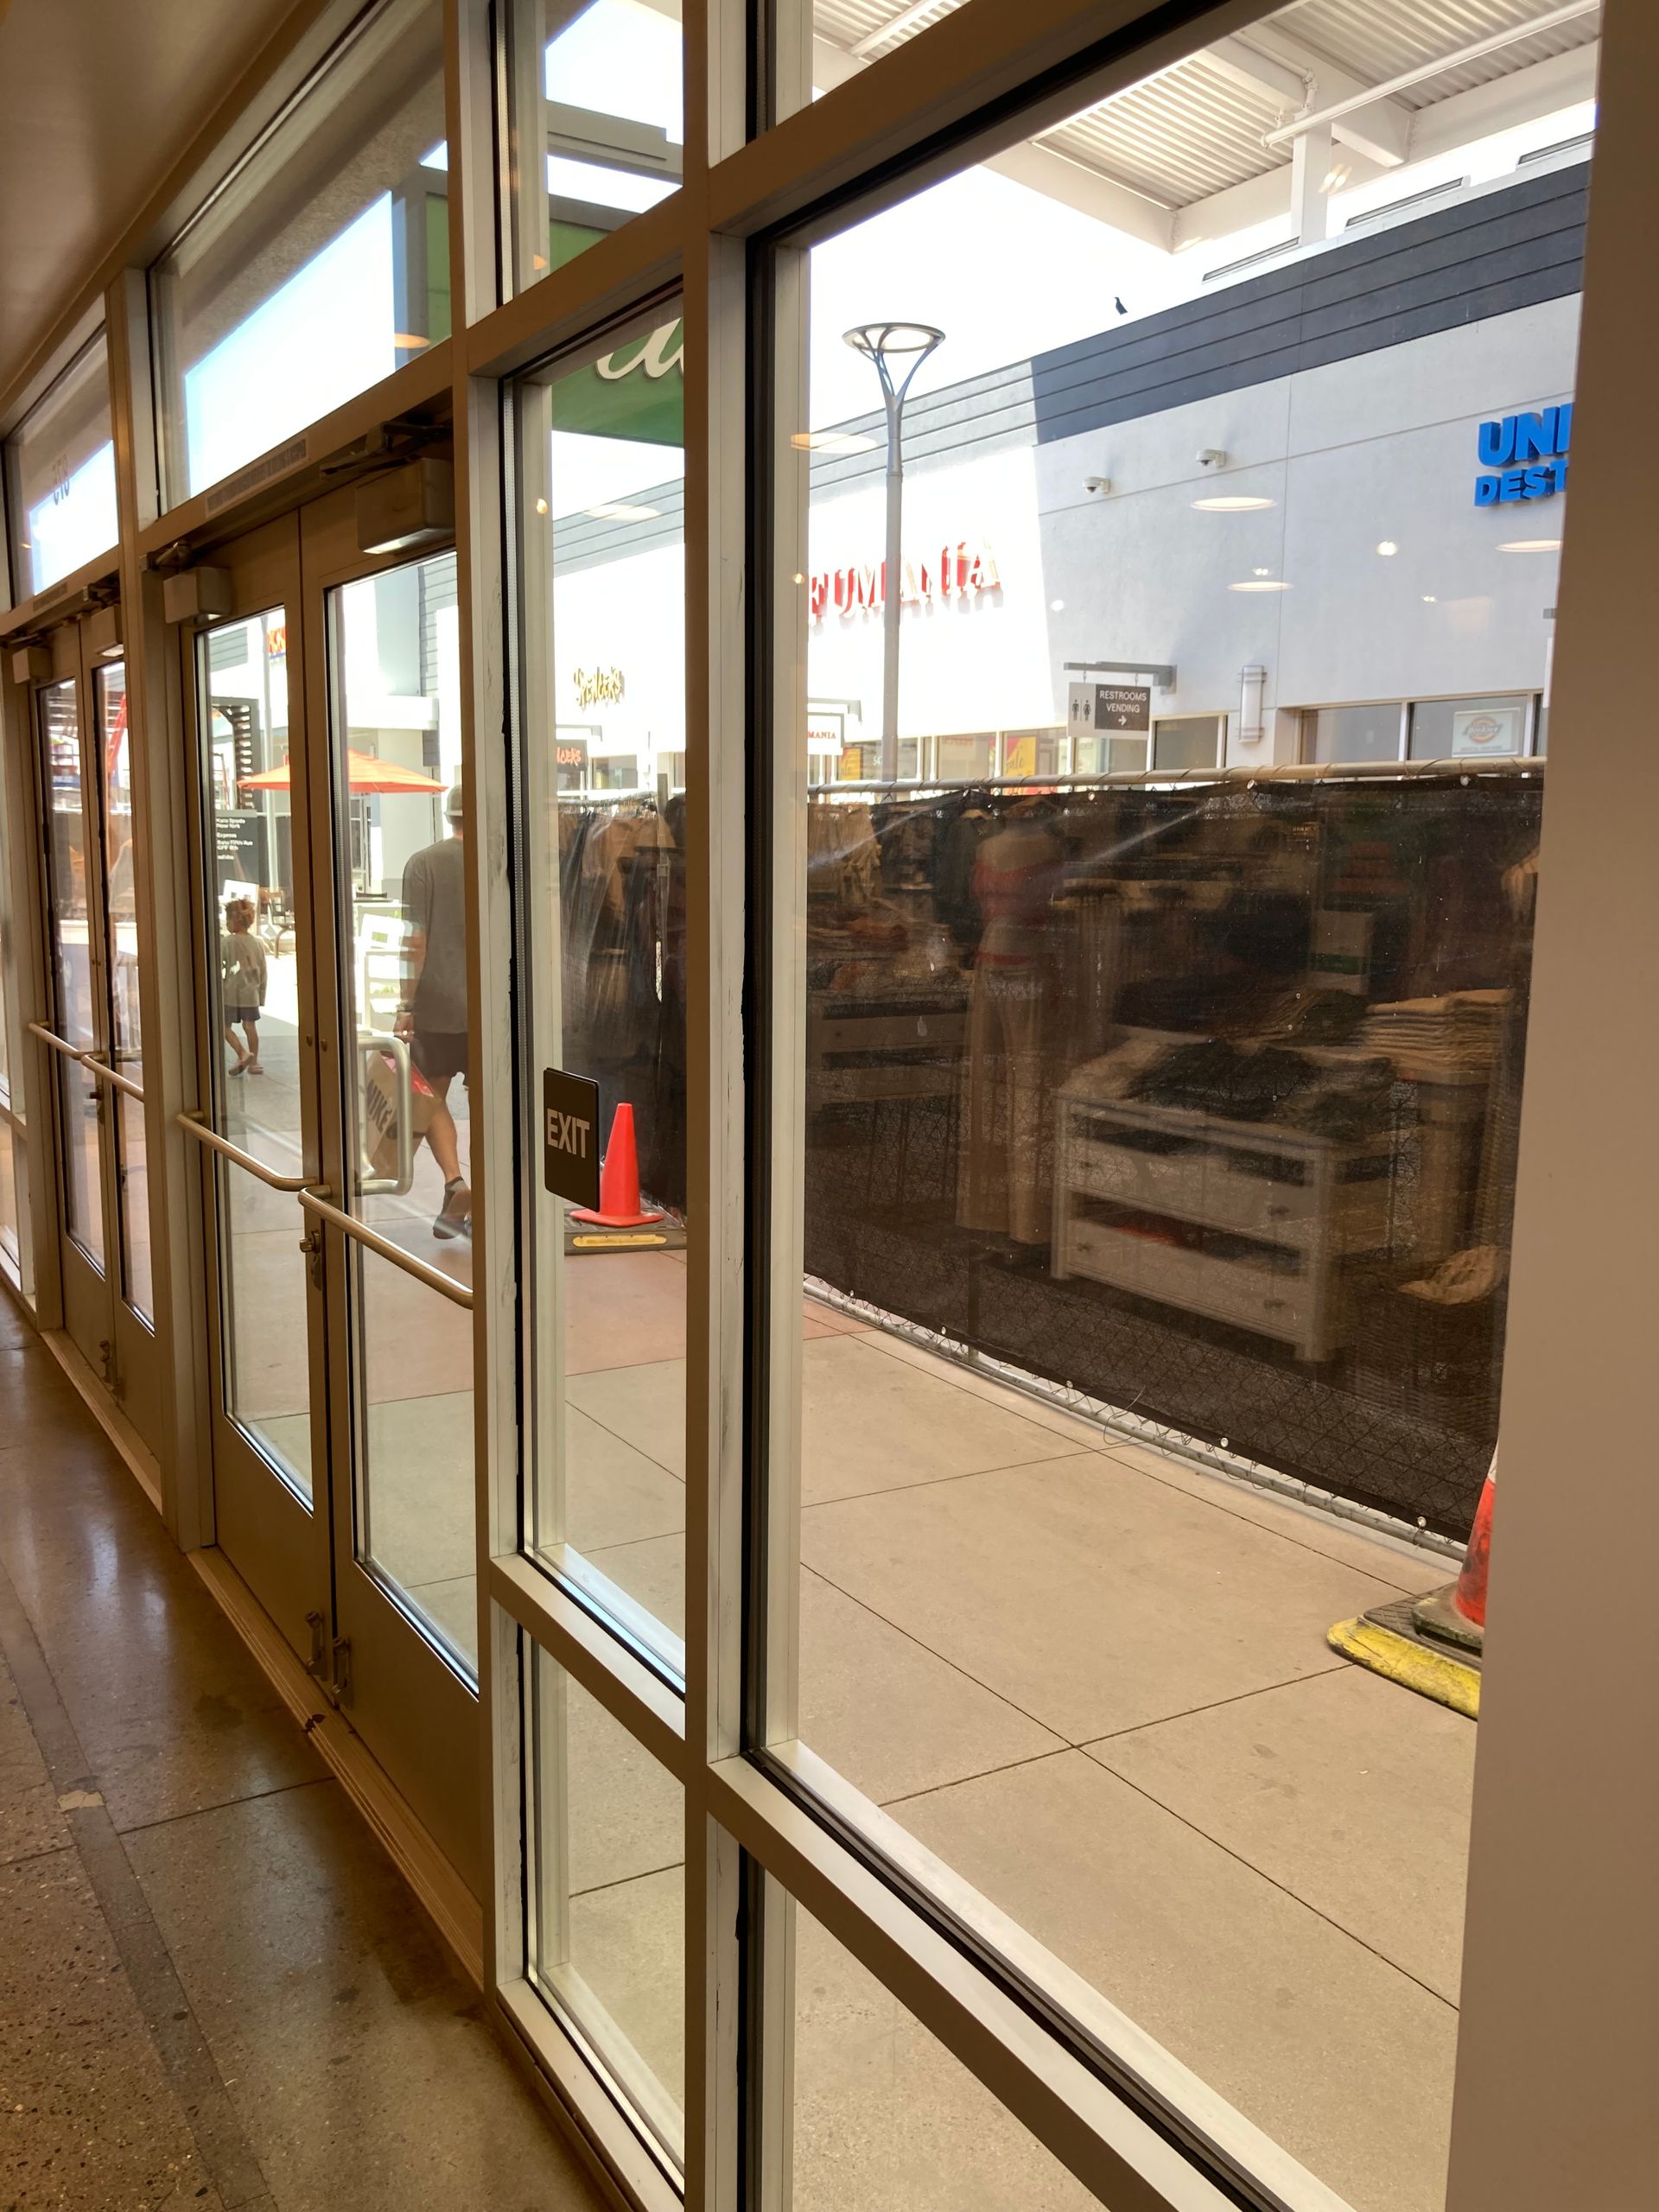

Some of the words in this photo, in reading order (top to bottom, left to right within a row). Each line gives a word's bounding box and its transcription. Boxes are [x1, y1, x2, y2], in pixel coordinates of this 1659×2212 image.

[1478, 402, 1574, 467] UNI
[1474, 459, 1569, 508] DEST
[1099, 690, 1147, 702] RESTROOMS
[1106, 702, 1141, 714] VENDING
[547, 1108, 590, 1159] EXIT
